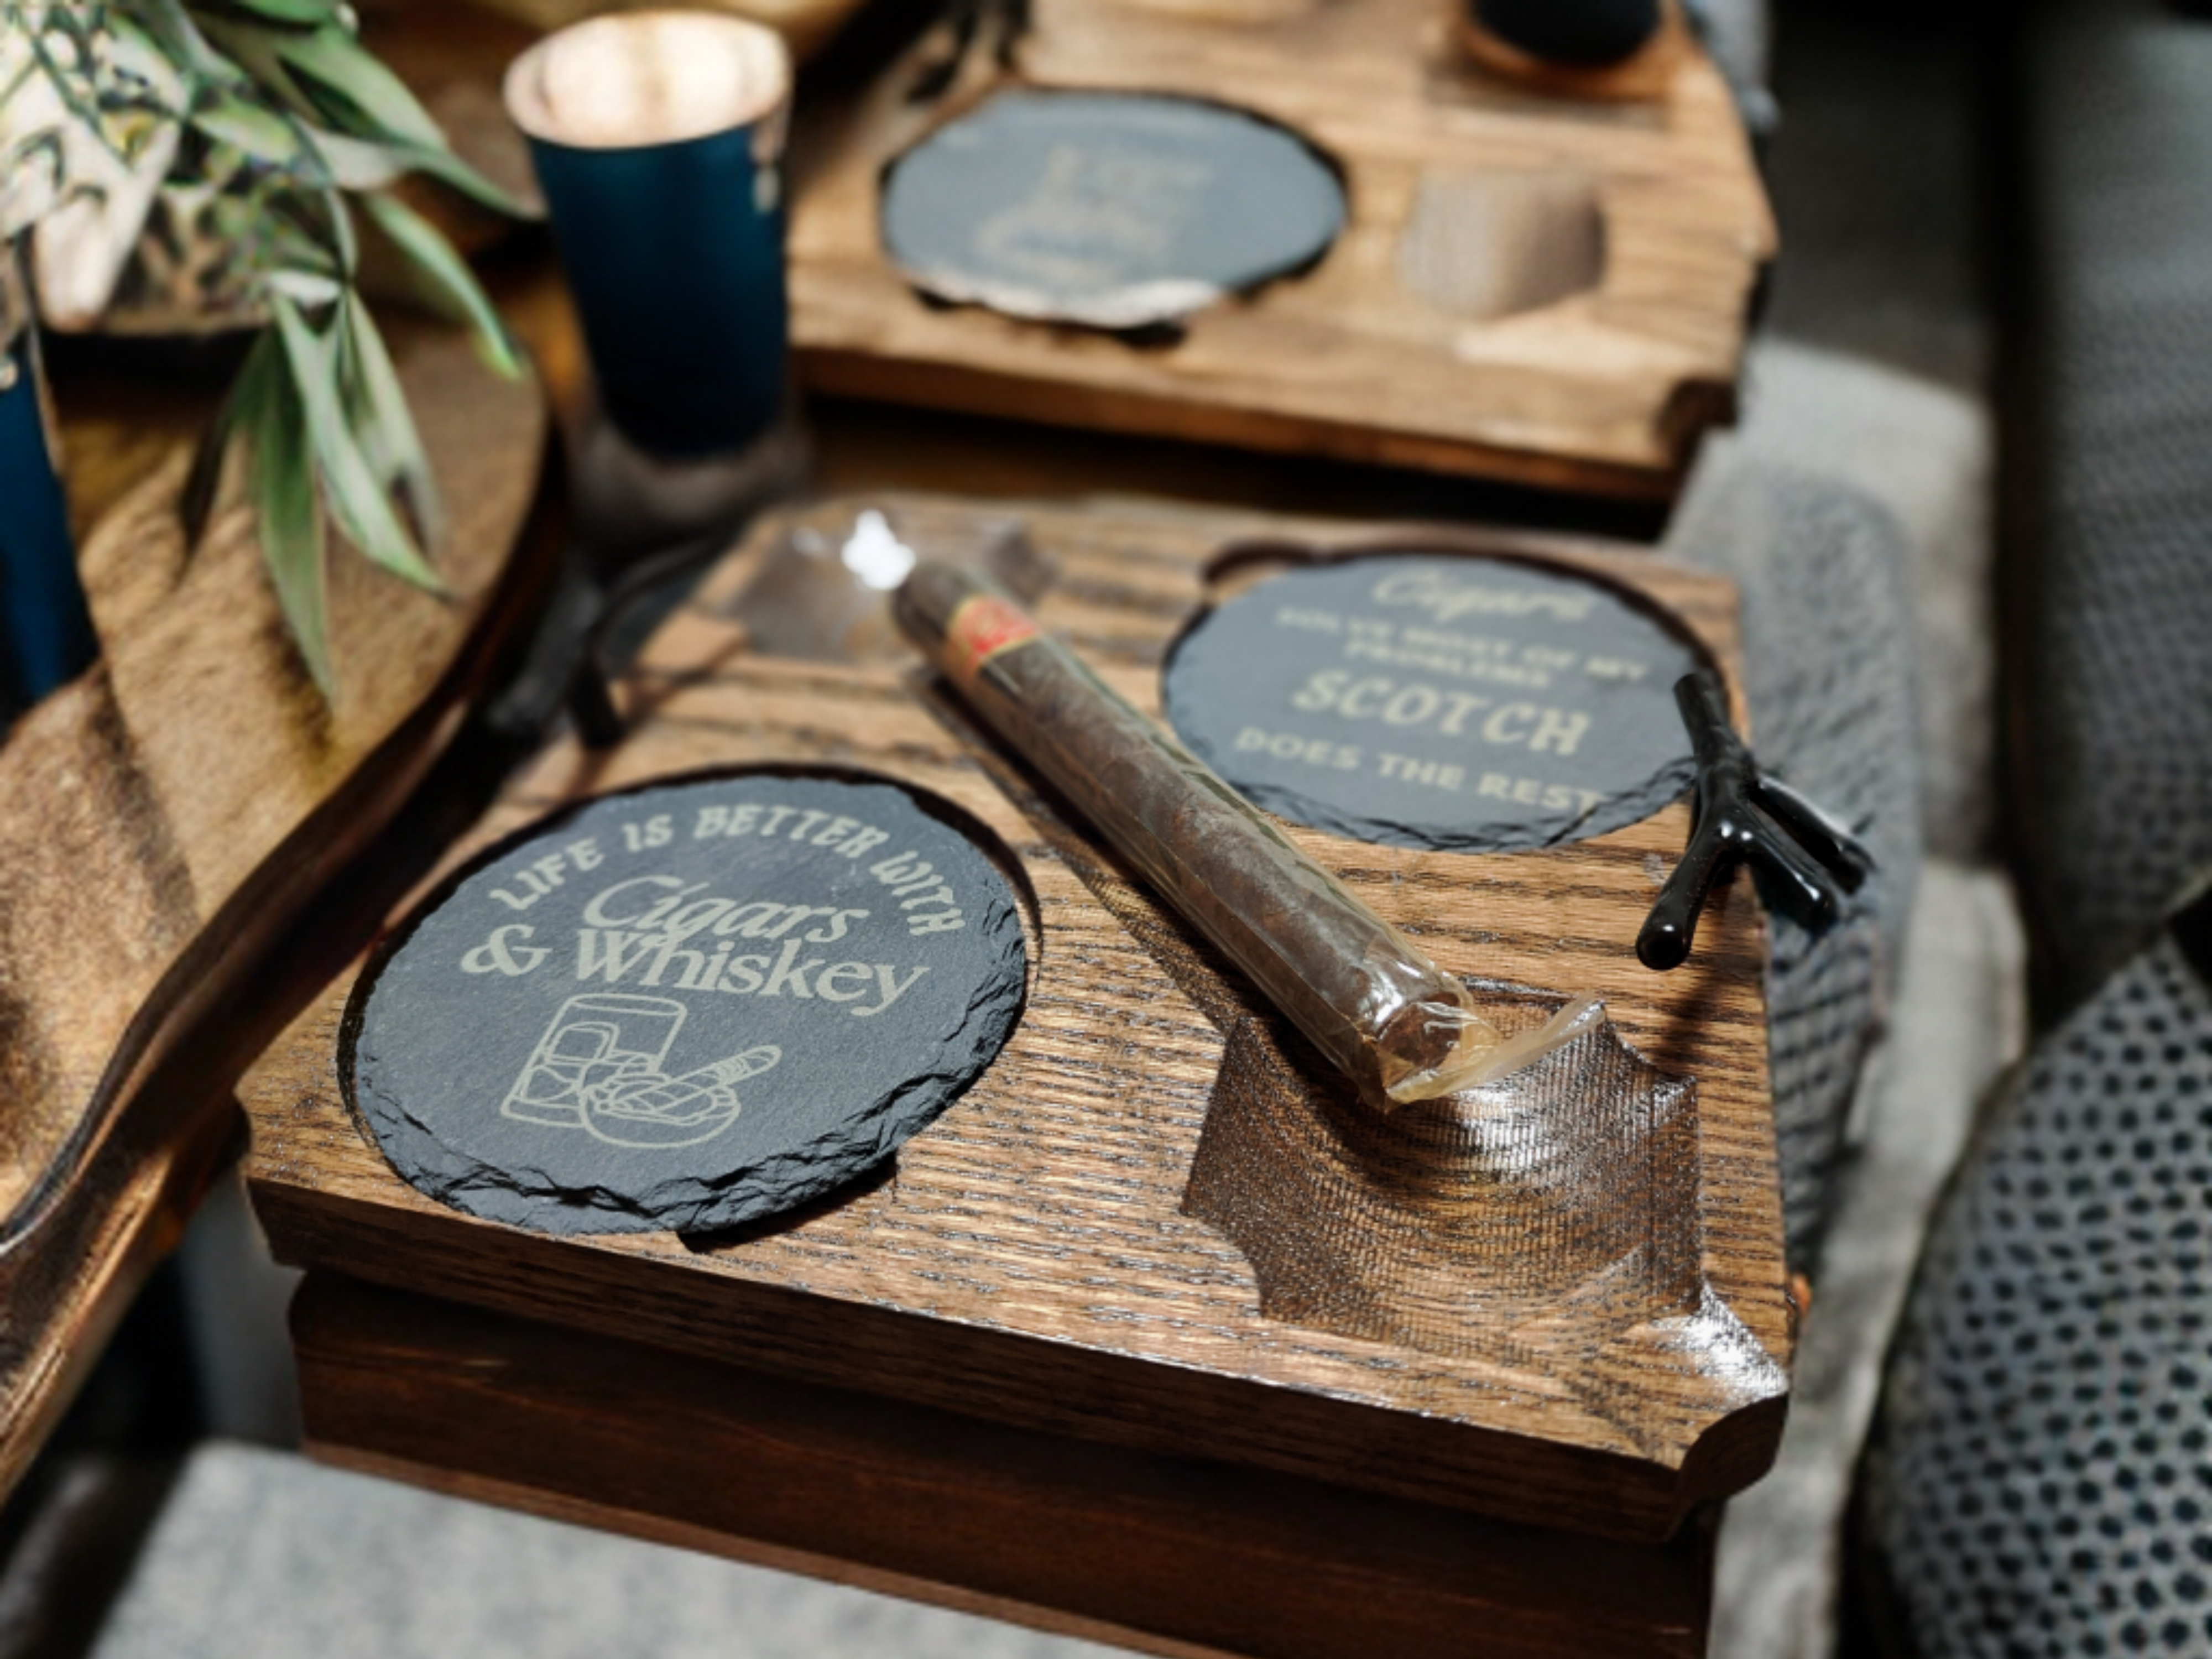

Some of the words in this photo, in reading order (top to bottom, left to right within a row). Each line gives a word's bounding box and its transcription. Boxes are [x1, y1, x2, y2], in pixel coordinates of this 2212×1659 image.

[1373, 568, 1594, 623] Cigars
[1522, 642, 1580, 668] OF
[1585, 655, 1650, 684] MY
[1292, 670, 1590, 754] SCOTCH
[1234, 726, 1360, 770] DOES
[1377, 751, 1465, 791] THE
[1476, 772, 1608, 815] REST
[489, 836, 606, 911] LIFE
[623, 813, 675, 853] IS
[692, 804, 891, 859] BETTER
[869, 849, 968, 937] WITH
[582, 875, 870, 951] Cigars
[460, 924, 552, 977] &
[573, 925, 931, 1018] Whiskey
